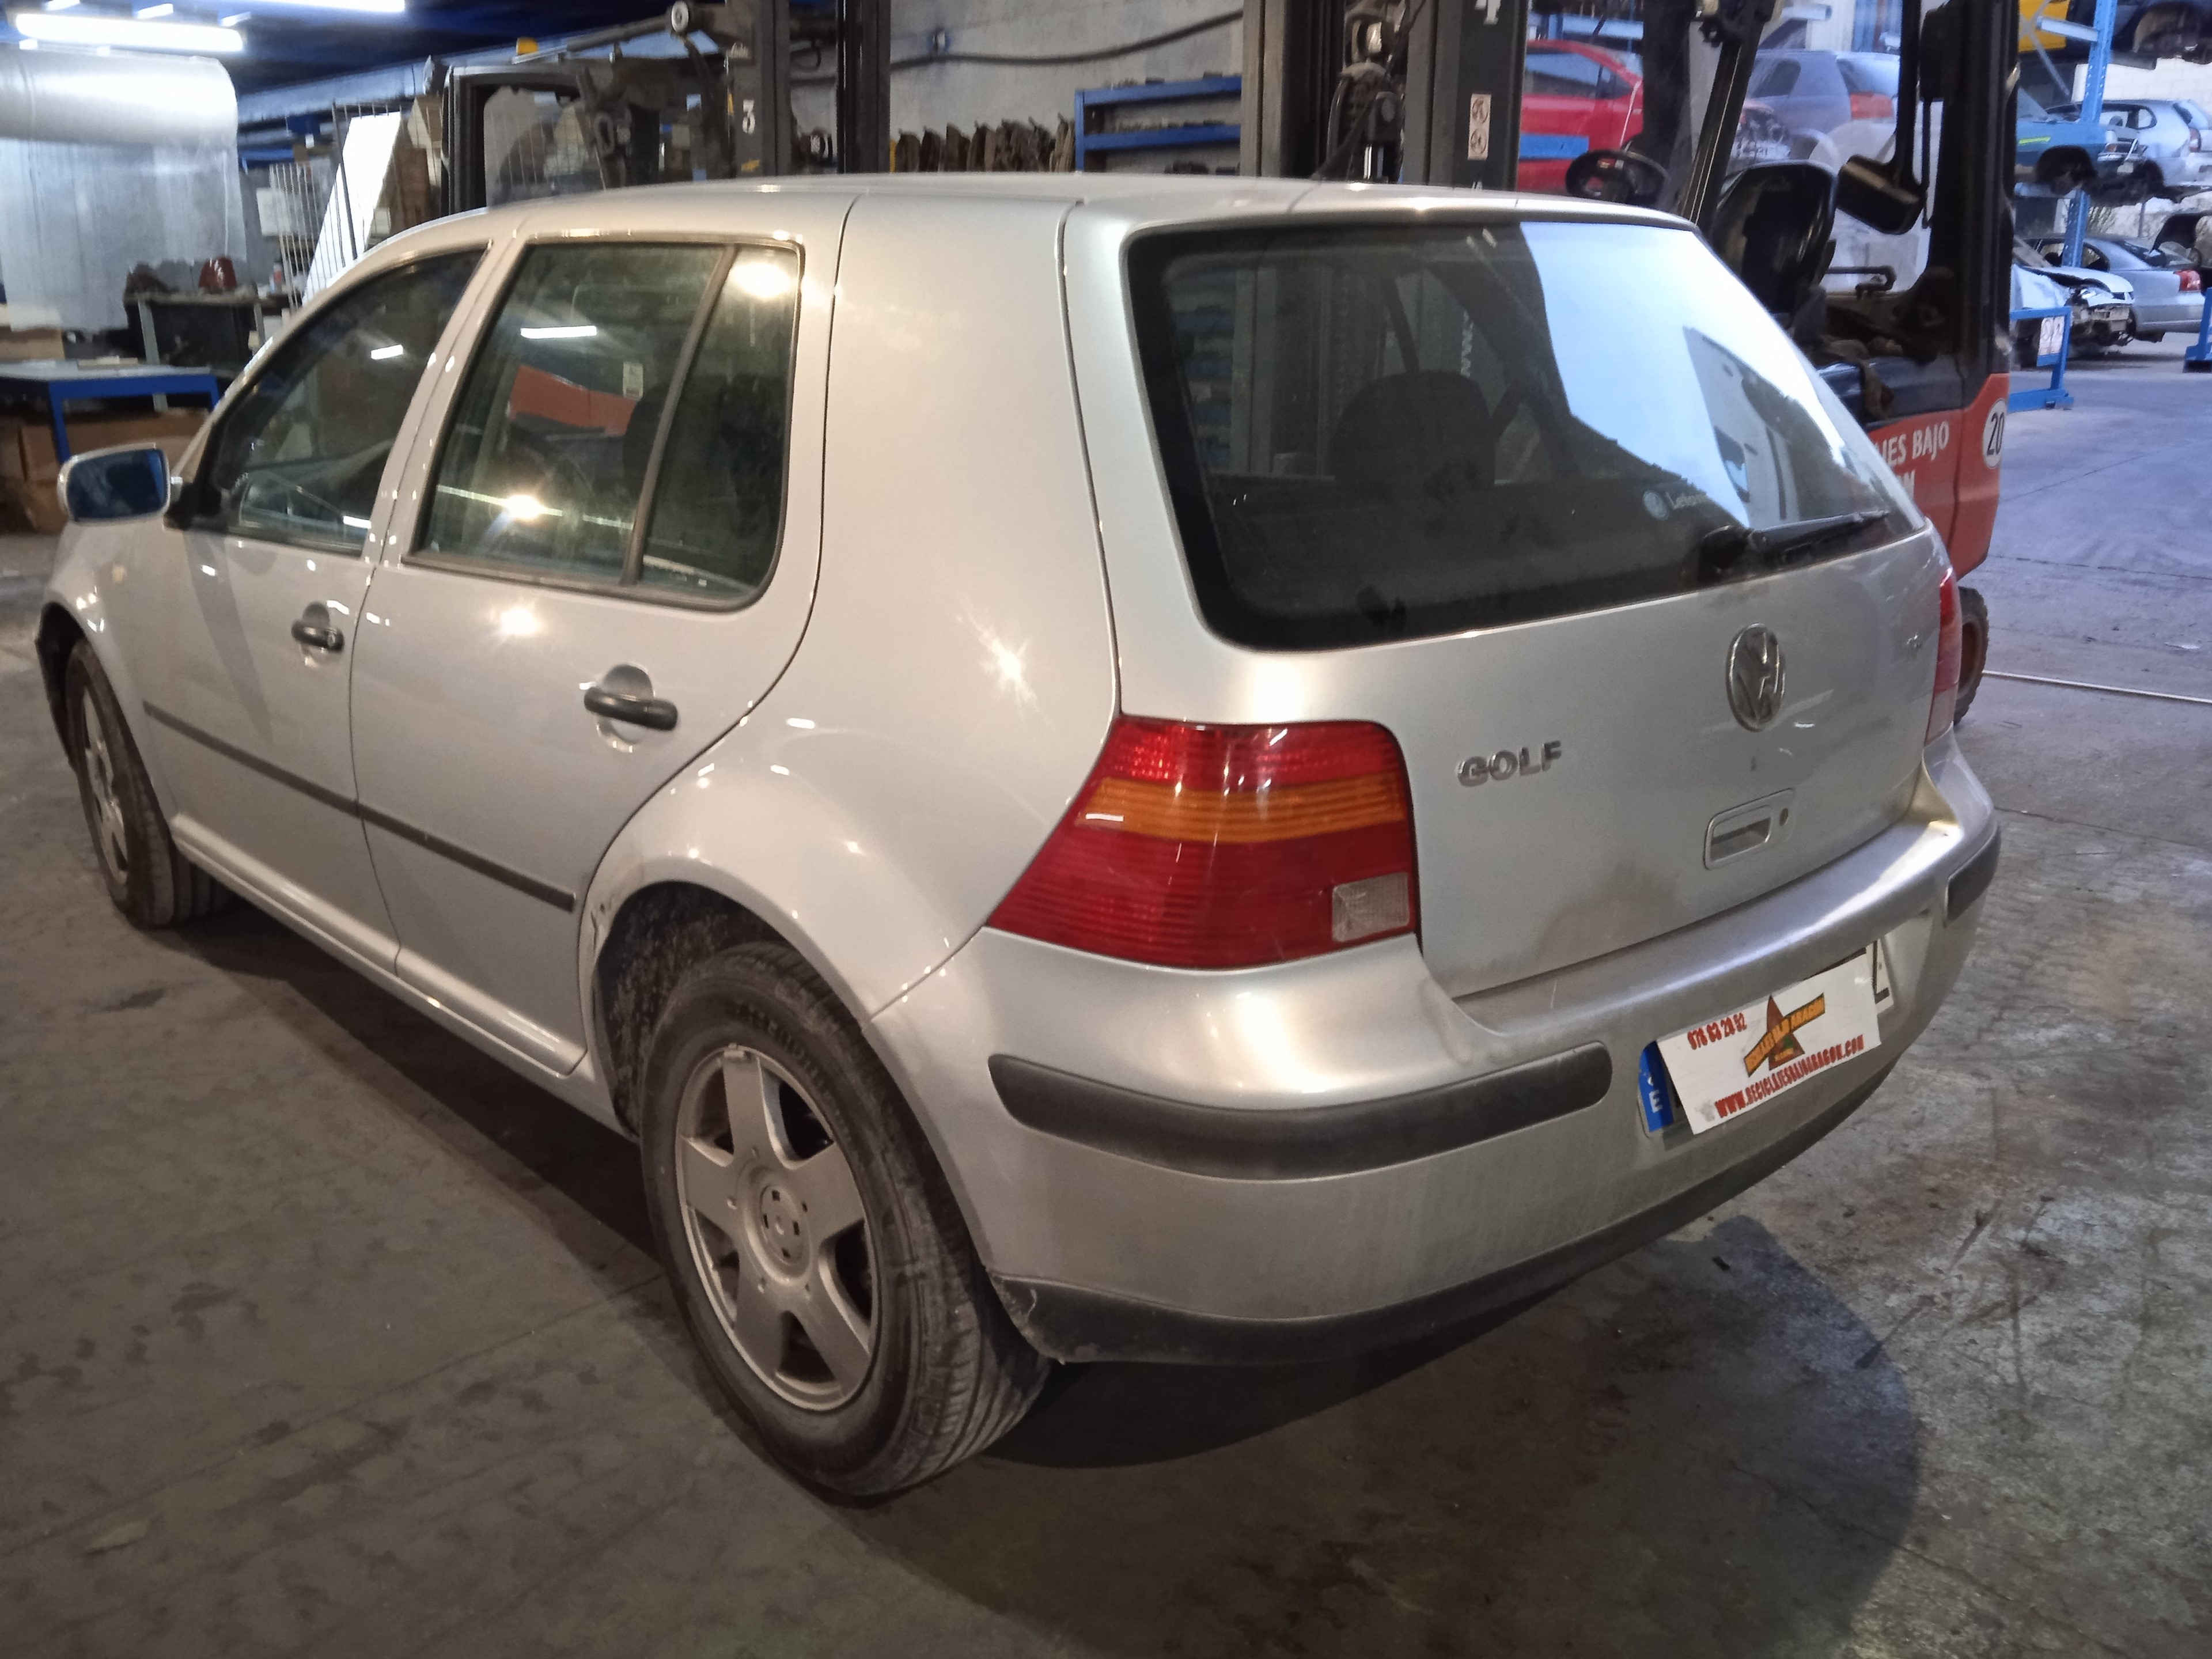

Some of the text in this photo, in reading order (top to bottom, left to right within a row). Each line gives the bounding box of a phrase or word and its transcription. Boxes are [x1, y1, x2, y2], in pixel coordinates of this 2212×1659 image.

[1912, 421, 1949, 461] BAJO
[1987, 412, 2005, 456] 20
[1456, 740, 1562, 787] GOLF
[1649, 1090, 1663, 1113] E
